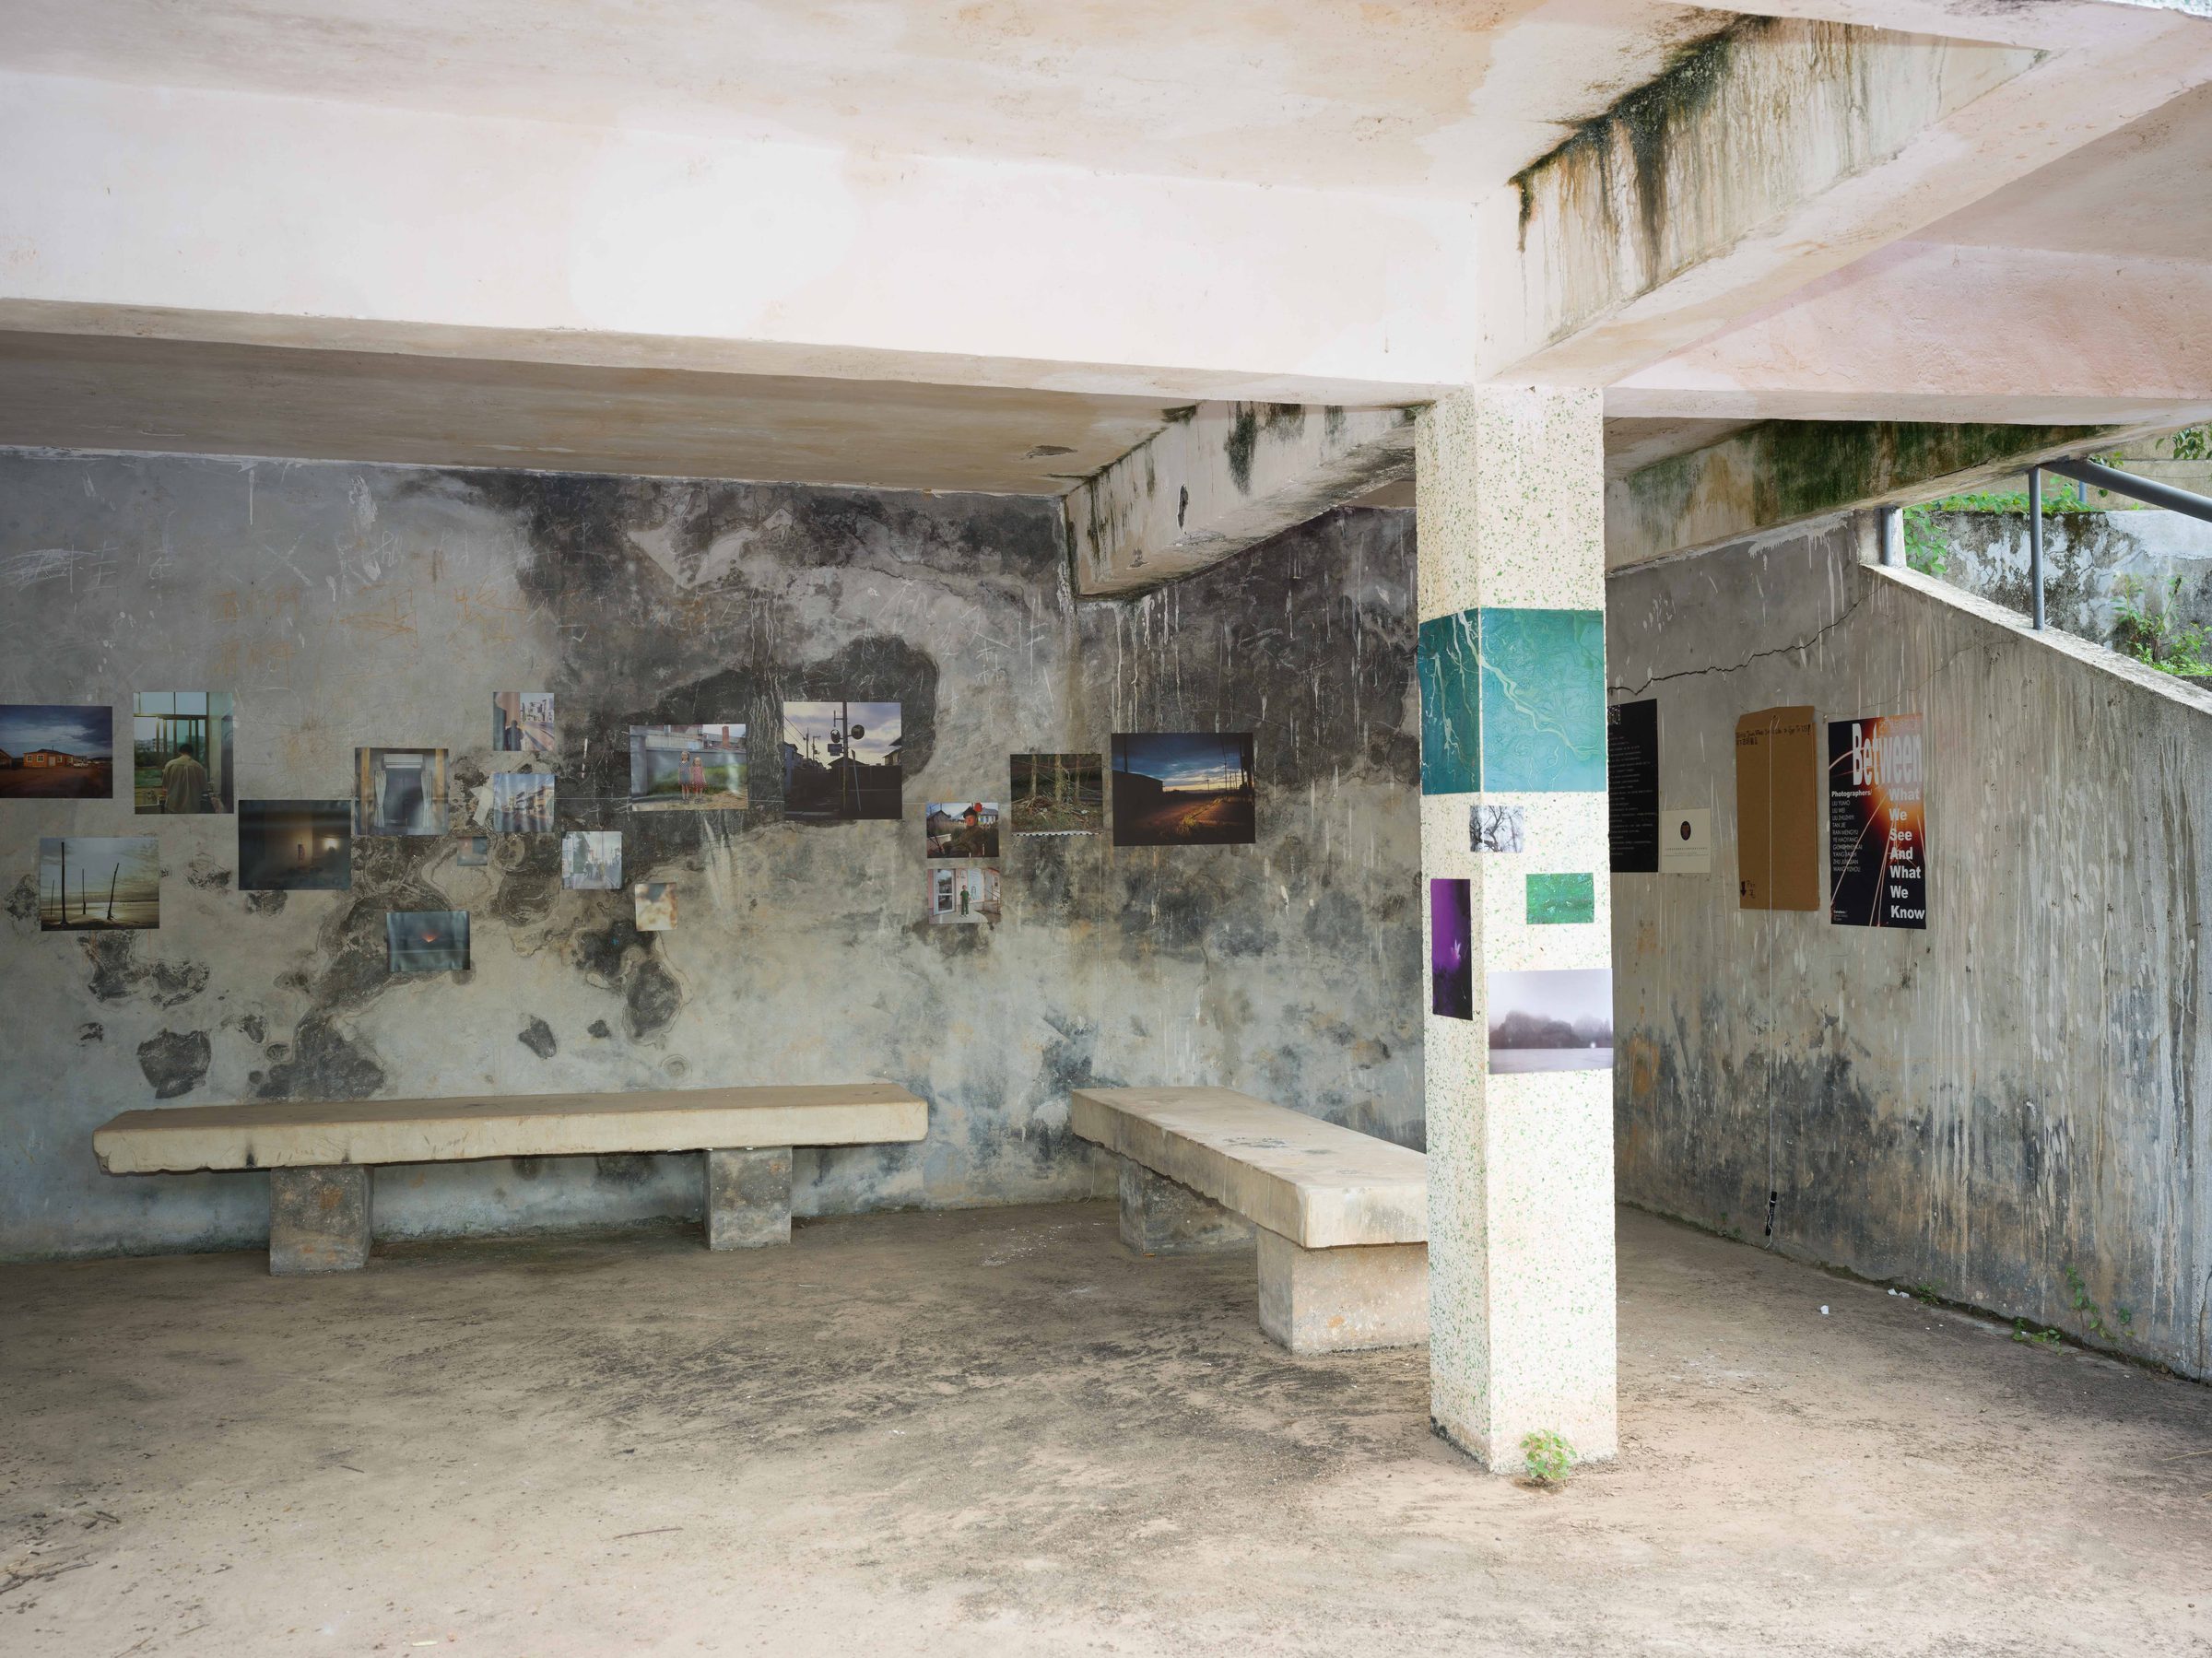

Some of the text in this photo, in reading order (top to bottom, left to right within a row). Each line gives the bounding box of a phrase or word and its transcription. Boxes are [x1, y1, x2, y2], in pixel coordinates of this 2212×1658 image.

[1852, 723, 1923, 786] Between
[1888, 788, 1921, 802] What
[1888, 806, 1908, 821] We
[1889, 828, 1912, 841] See
[1889, 846, 1913, 860] And
[1890, 864, 1921, 879] What
[1890, 885, 1909, 899] We
[1890, 904, 1925, 920] Know
